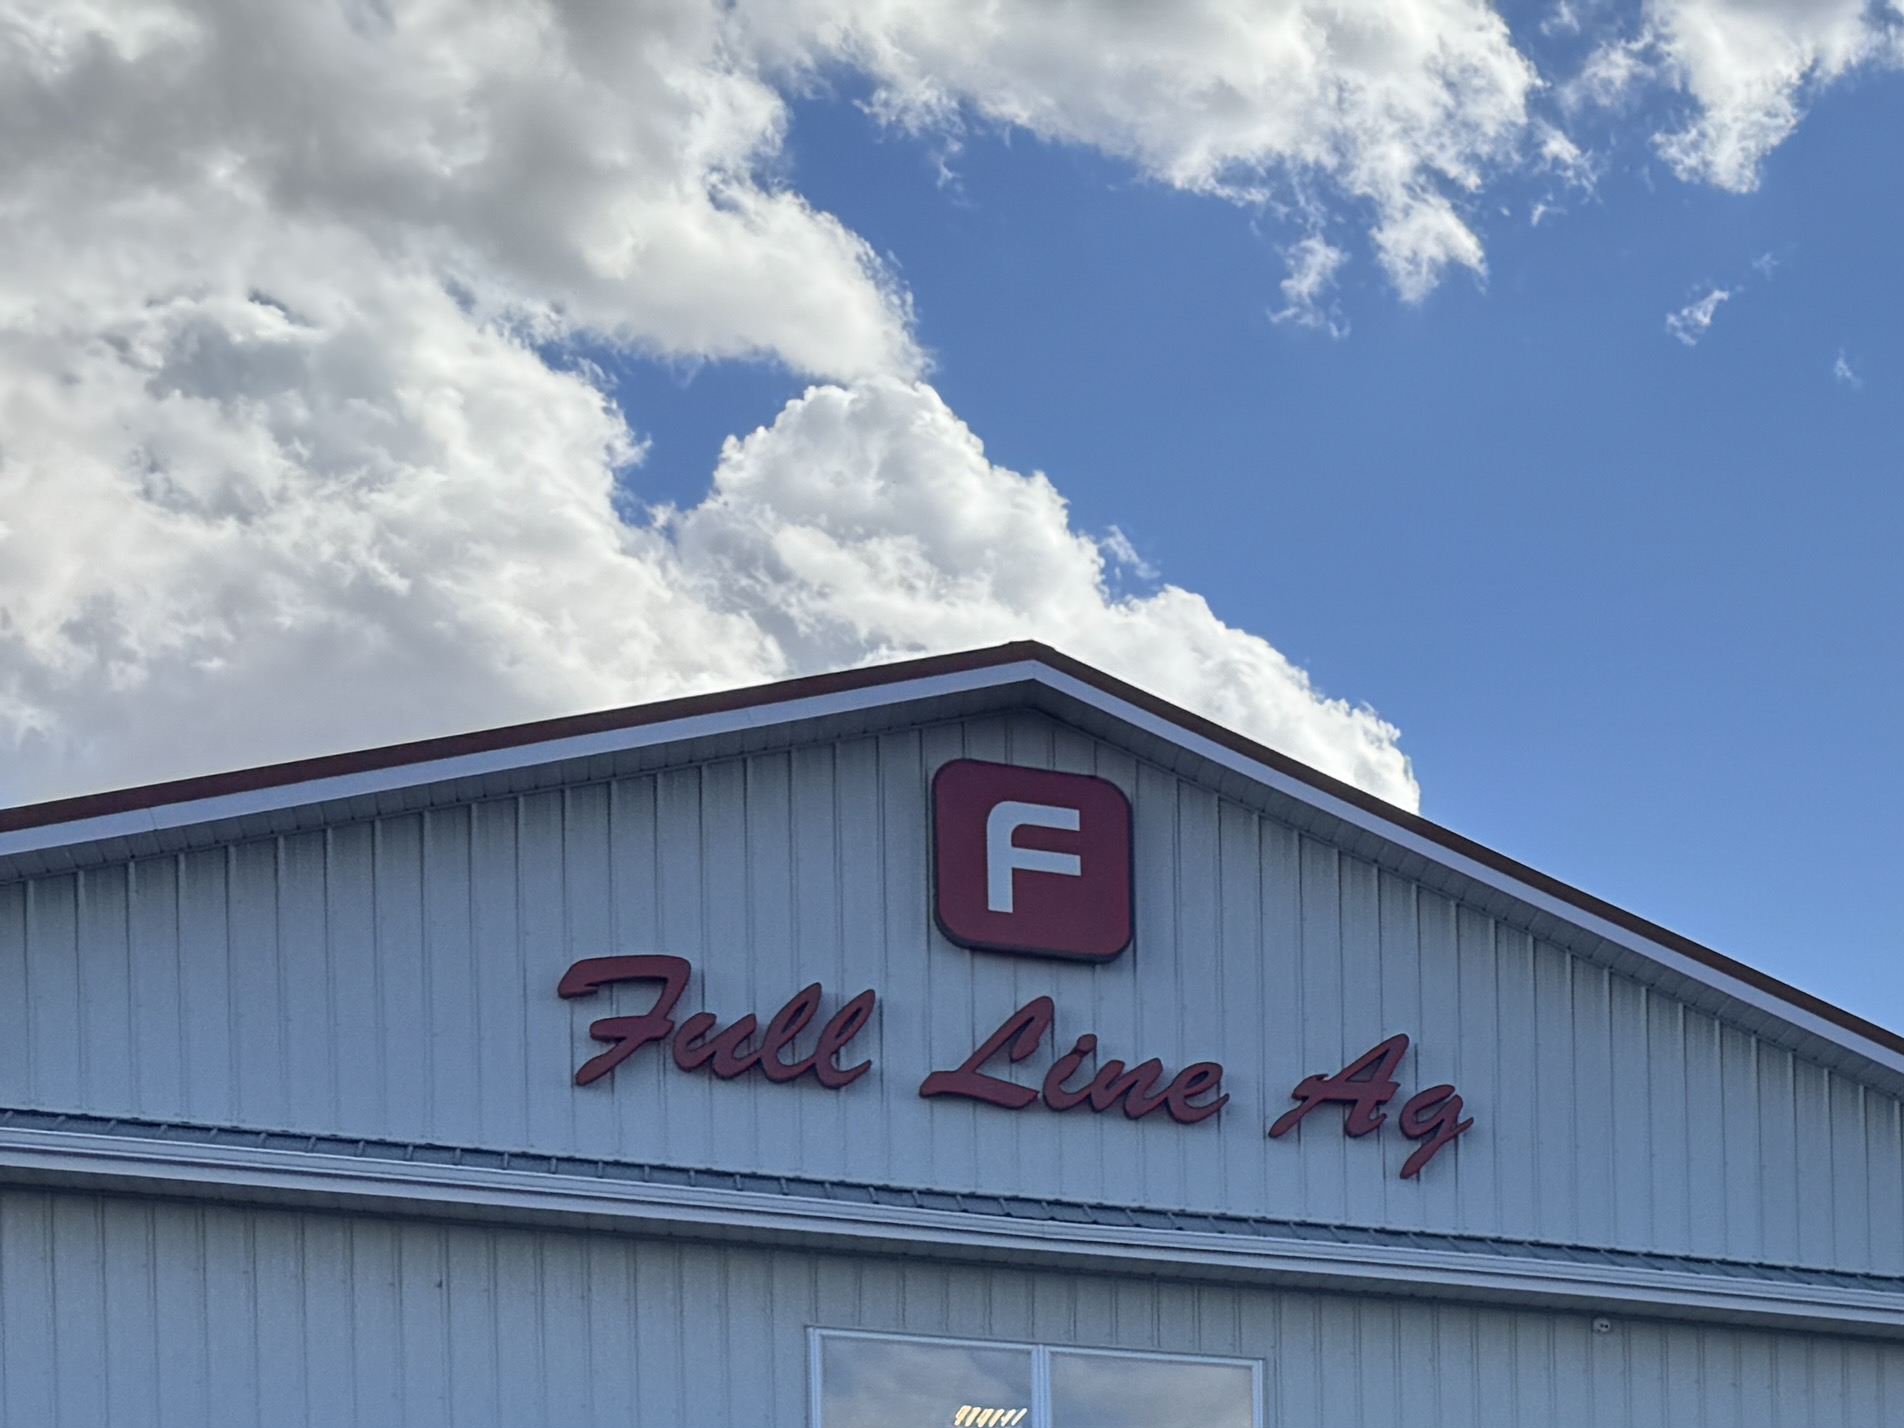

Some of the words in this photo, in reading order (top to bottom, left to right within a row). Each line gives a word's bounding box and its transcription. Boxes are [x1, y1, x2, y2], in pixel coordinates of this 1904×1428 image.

[986, 800, 1081, 914] F
[556, 953, 878, 1089] Full
[919, 994, 1231, 1125] Line
[1267, 1033, 1475, 1180] Ag
